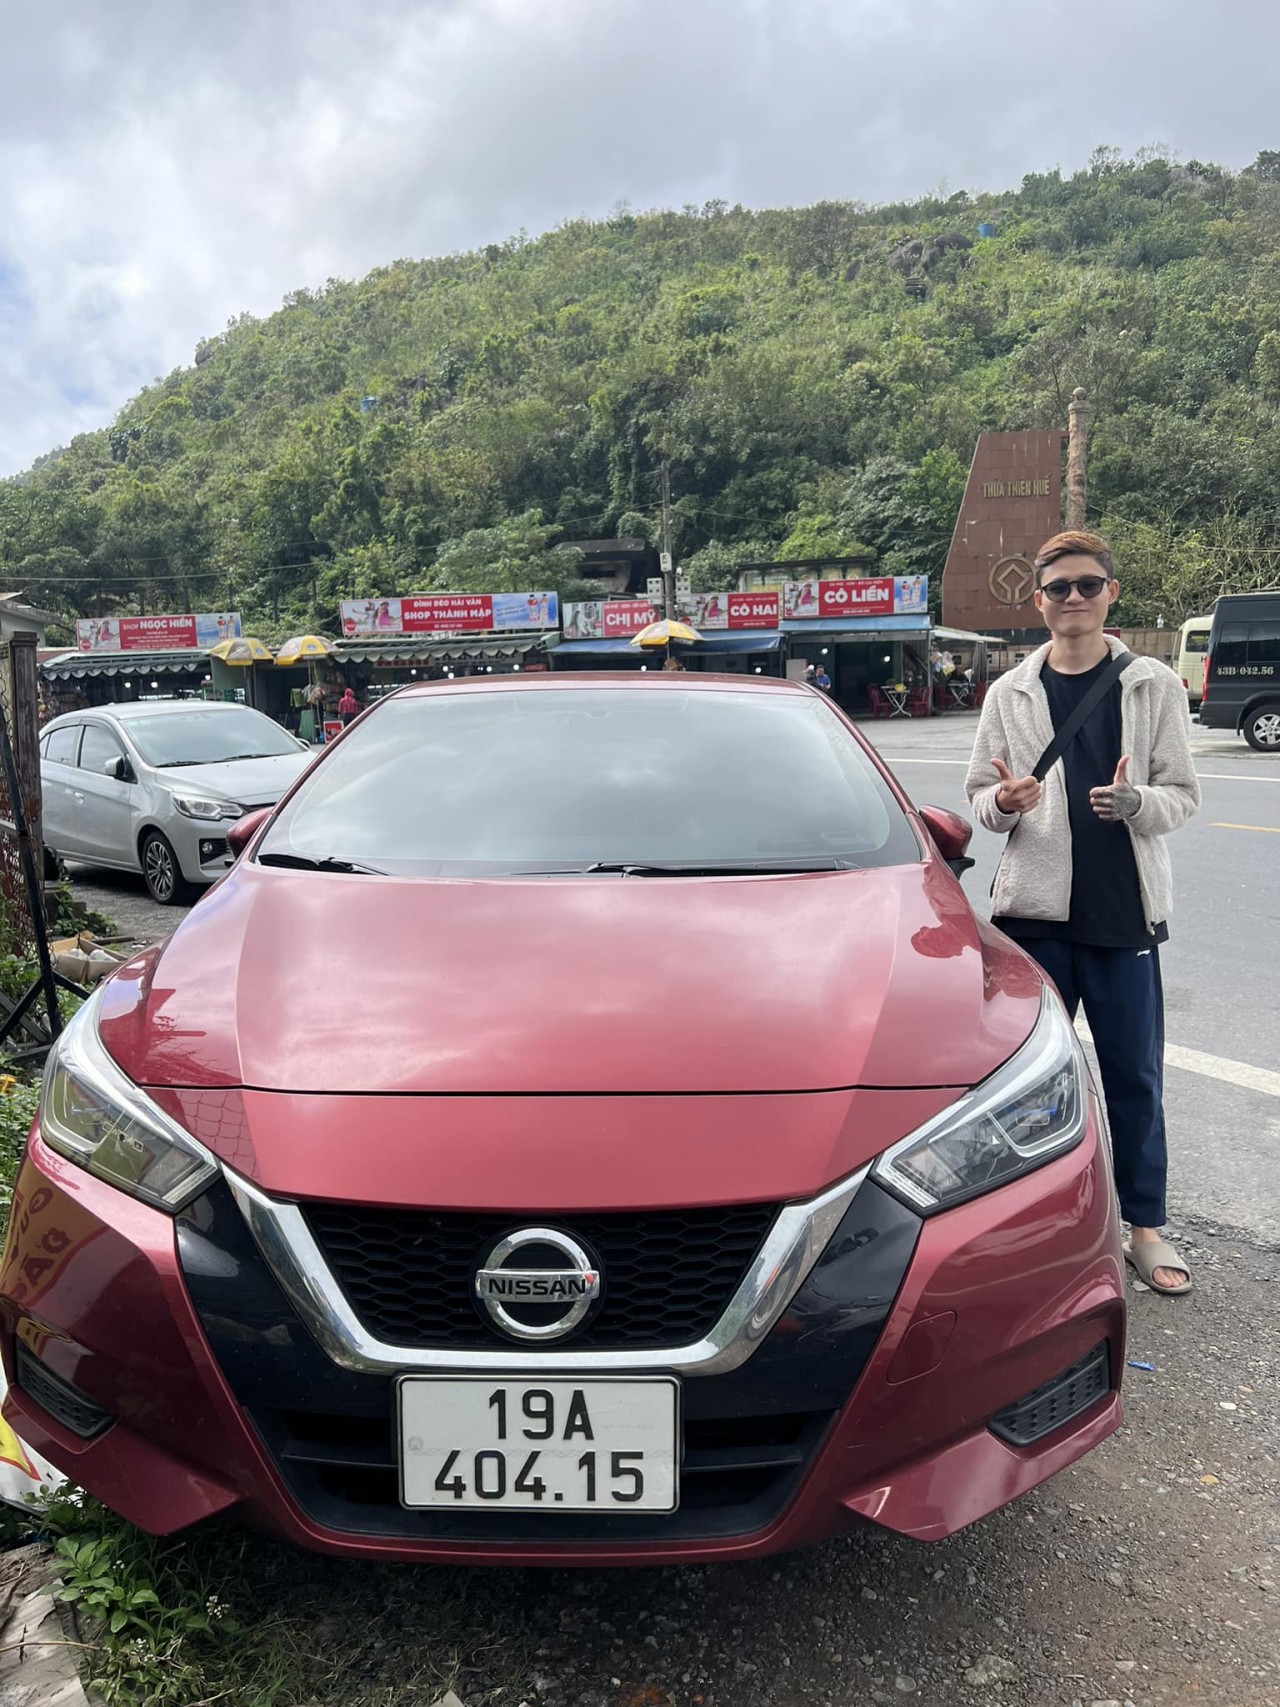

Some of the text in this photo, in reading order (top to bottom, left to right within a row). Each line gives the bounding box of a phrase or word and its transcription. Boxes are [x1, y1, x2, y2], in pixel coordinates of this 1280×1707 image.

[824, 587, 848, 604] CÔ
[404, 611, 431, 621] SHOP
[730, 602, 778, 617] CÔ HAI
[140, 619, 168, 631] NGỌC
[606, 612, 631, 628] CHỊ
[488, 1277, 586, 1296] NISSAN
[488, 1389, 595, 1441] 19A
[434, 1449, 644, 1502] 404.15
